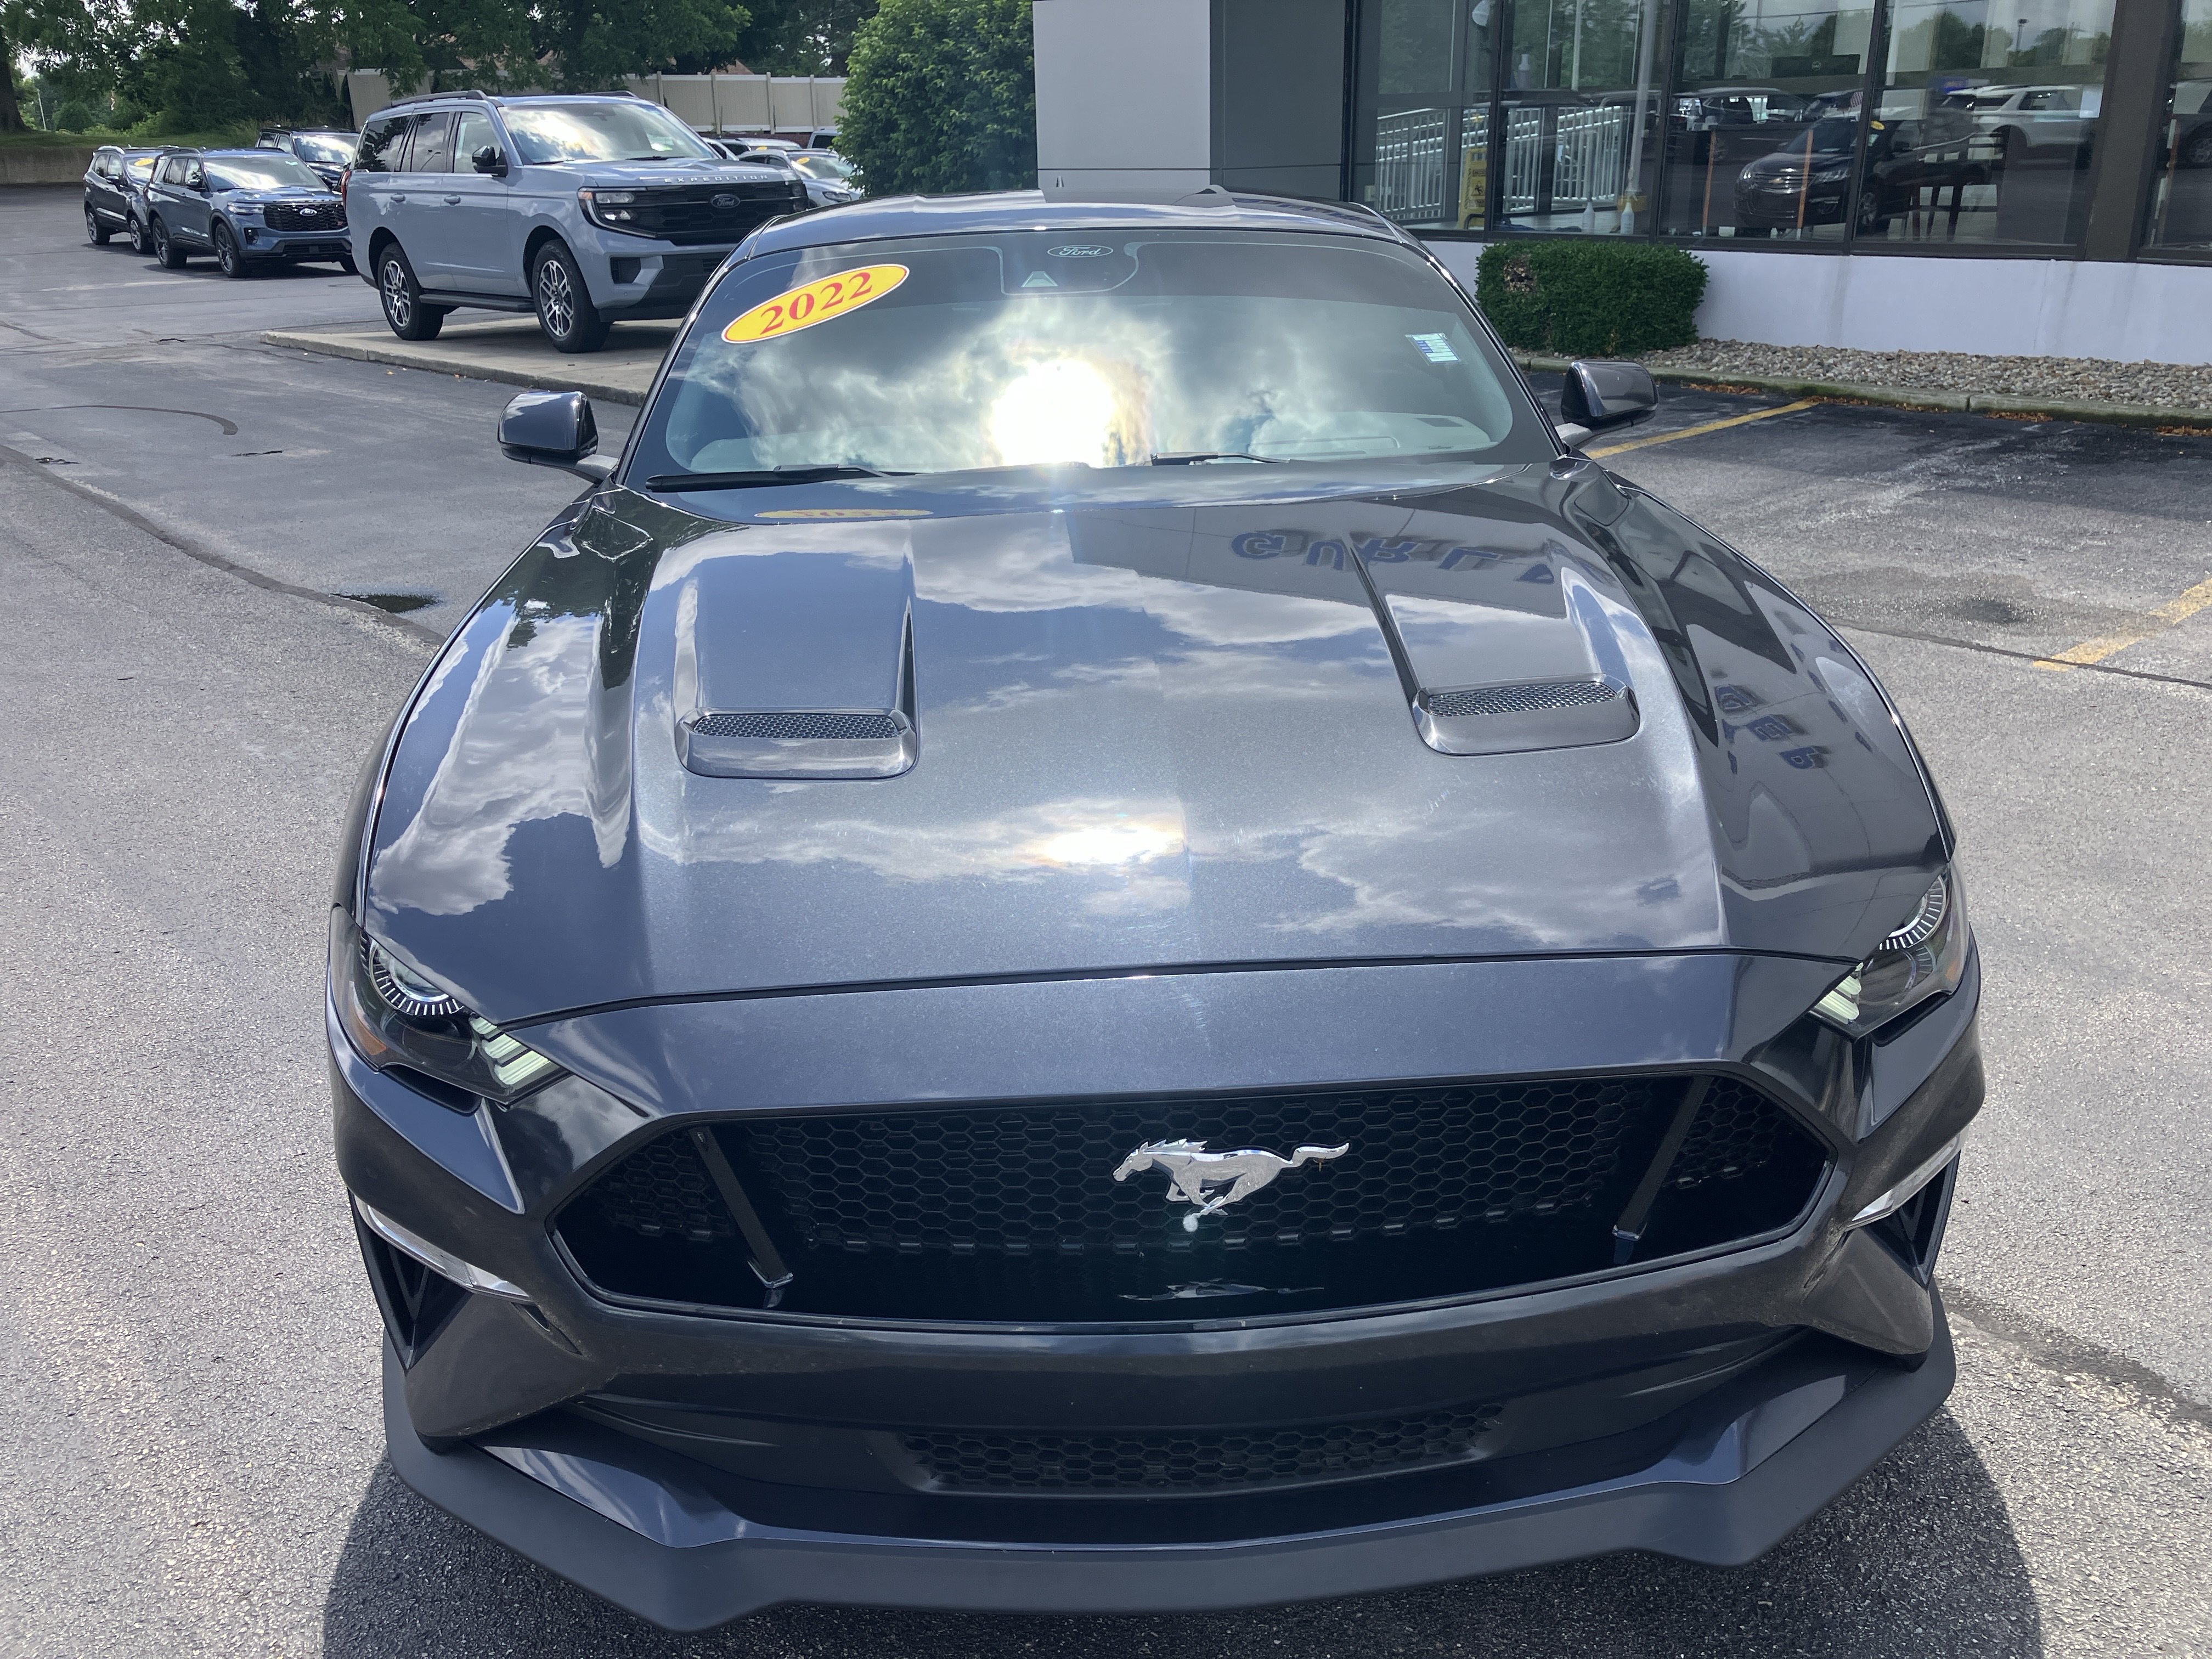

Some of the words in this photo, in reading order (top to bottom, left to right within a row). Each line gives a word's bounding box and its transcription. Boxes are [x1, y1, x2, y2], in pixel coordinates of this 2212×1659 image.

[664, 175, 768, 183] EXPEDITION
[717, 198, 735, 206] Ford
[1059, 246, 1102, 256] Ford
[760, 272, 873, 335] 2022
